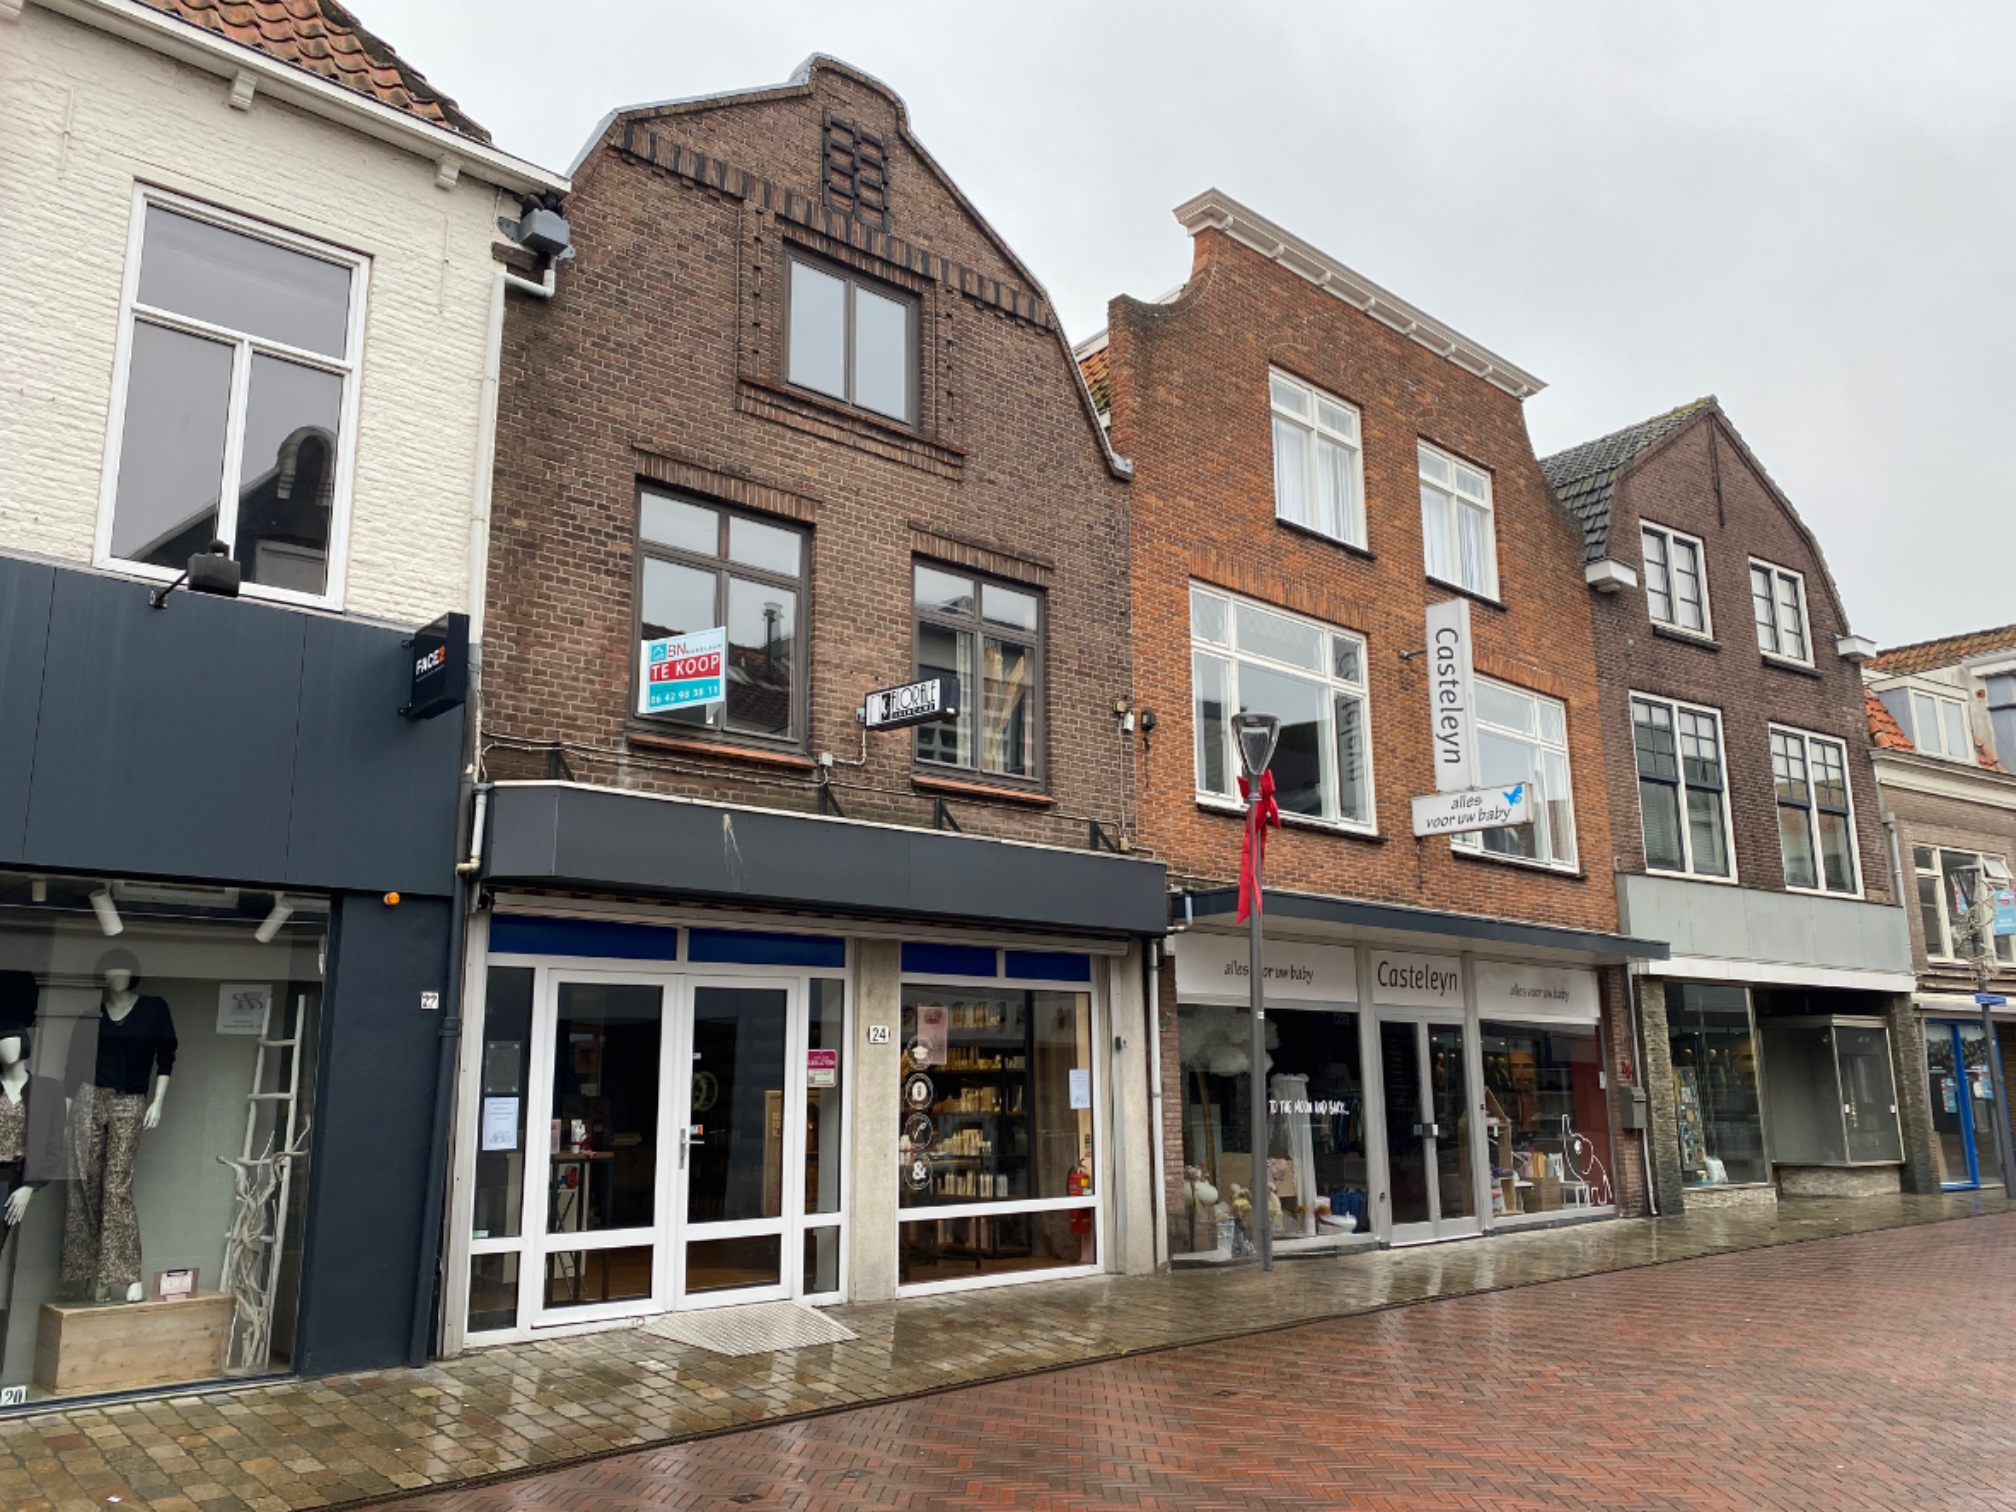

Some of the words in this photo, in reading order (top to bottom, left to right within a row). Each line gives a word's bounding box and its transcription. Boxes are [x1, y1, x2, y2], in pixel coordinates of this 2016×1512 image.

[668, 642, 686, 658] BN
[651, 664, 670, 680] TE
[675, 654, 719, 677] KOOP
[708, 685, 719, 695] 11
[1436, 627, 1464, 764] Casteleyn
[1451, 795, 1482, 810] alles
[1426, 815, 1456, 828] voor
[1457, 813, 1476, 825] uw
[1478, 805, 1512, 823] baby
[1224, 960, 1249, 977] alles
[1275, 968, 1289, 979] uw
[1290, 963, 1314, 986] baby
[1377, 960, 1458, 997] Casteleyn
[872, 1026, 887, 1042] 24
[4, 1389, 23, 1404] 20
